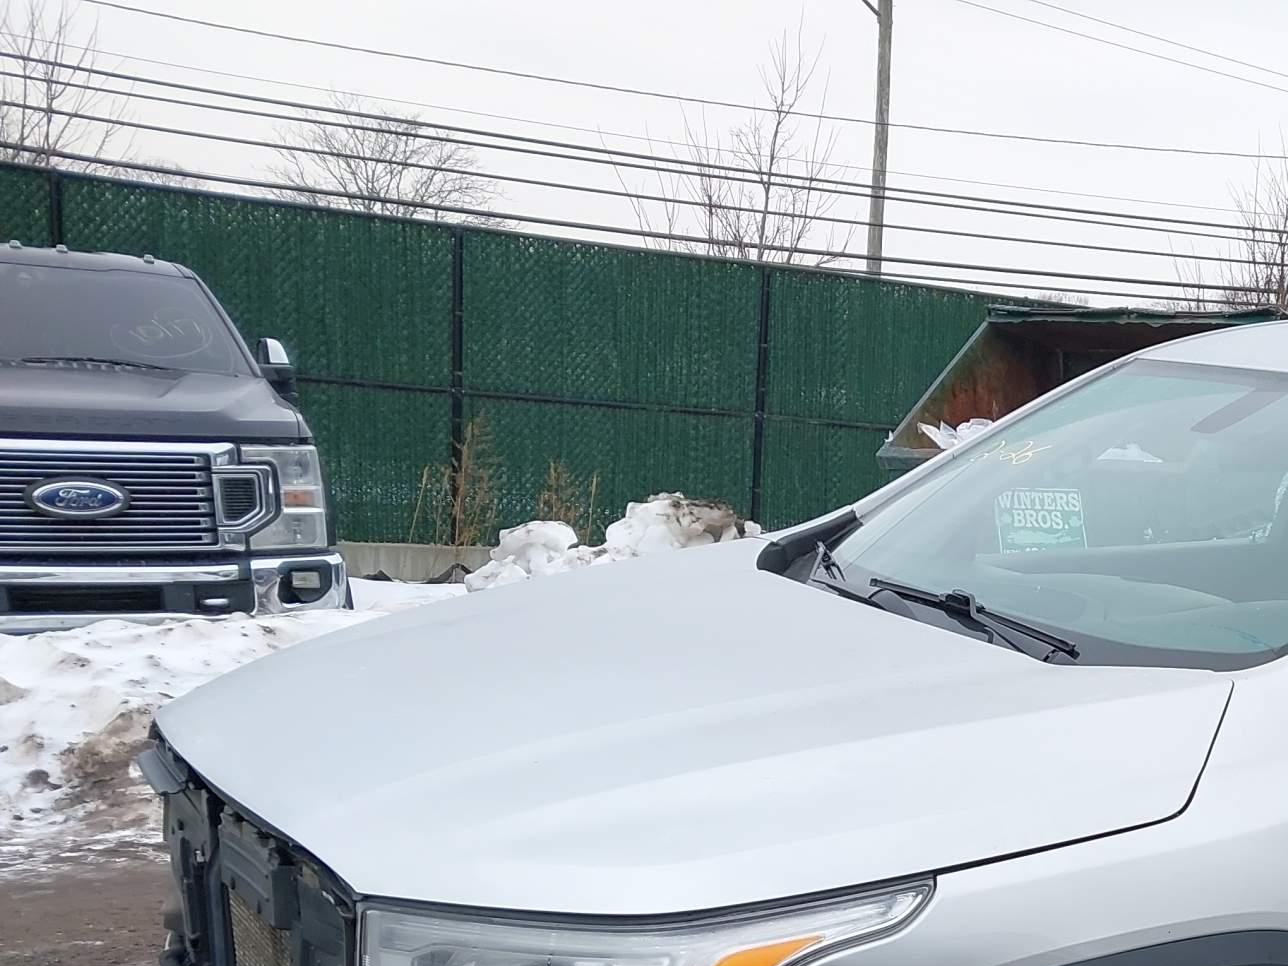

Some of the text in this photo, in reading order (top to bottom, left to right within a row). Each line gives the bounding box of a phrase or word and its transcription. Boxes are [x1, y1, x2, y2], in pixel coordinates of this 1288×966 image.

[55, 488, 103, 507] Ford
[998, 491, 1080, 511] WINTERS
[1012, 510, 1070, 529] BROS.
